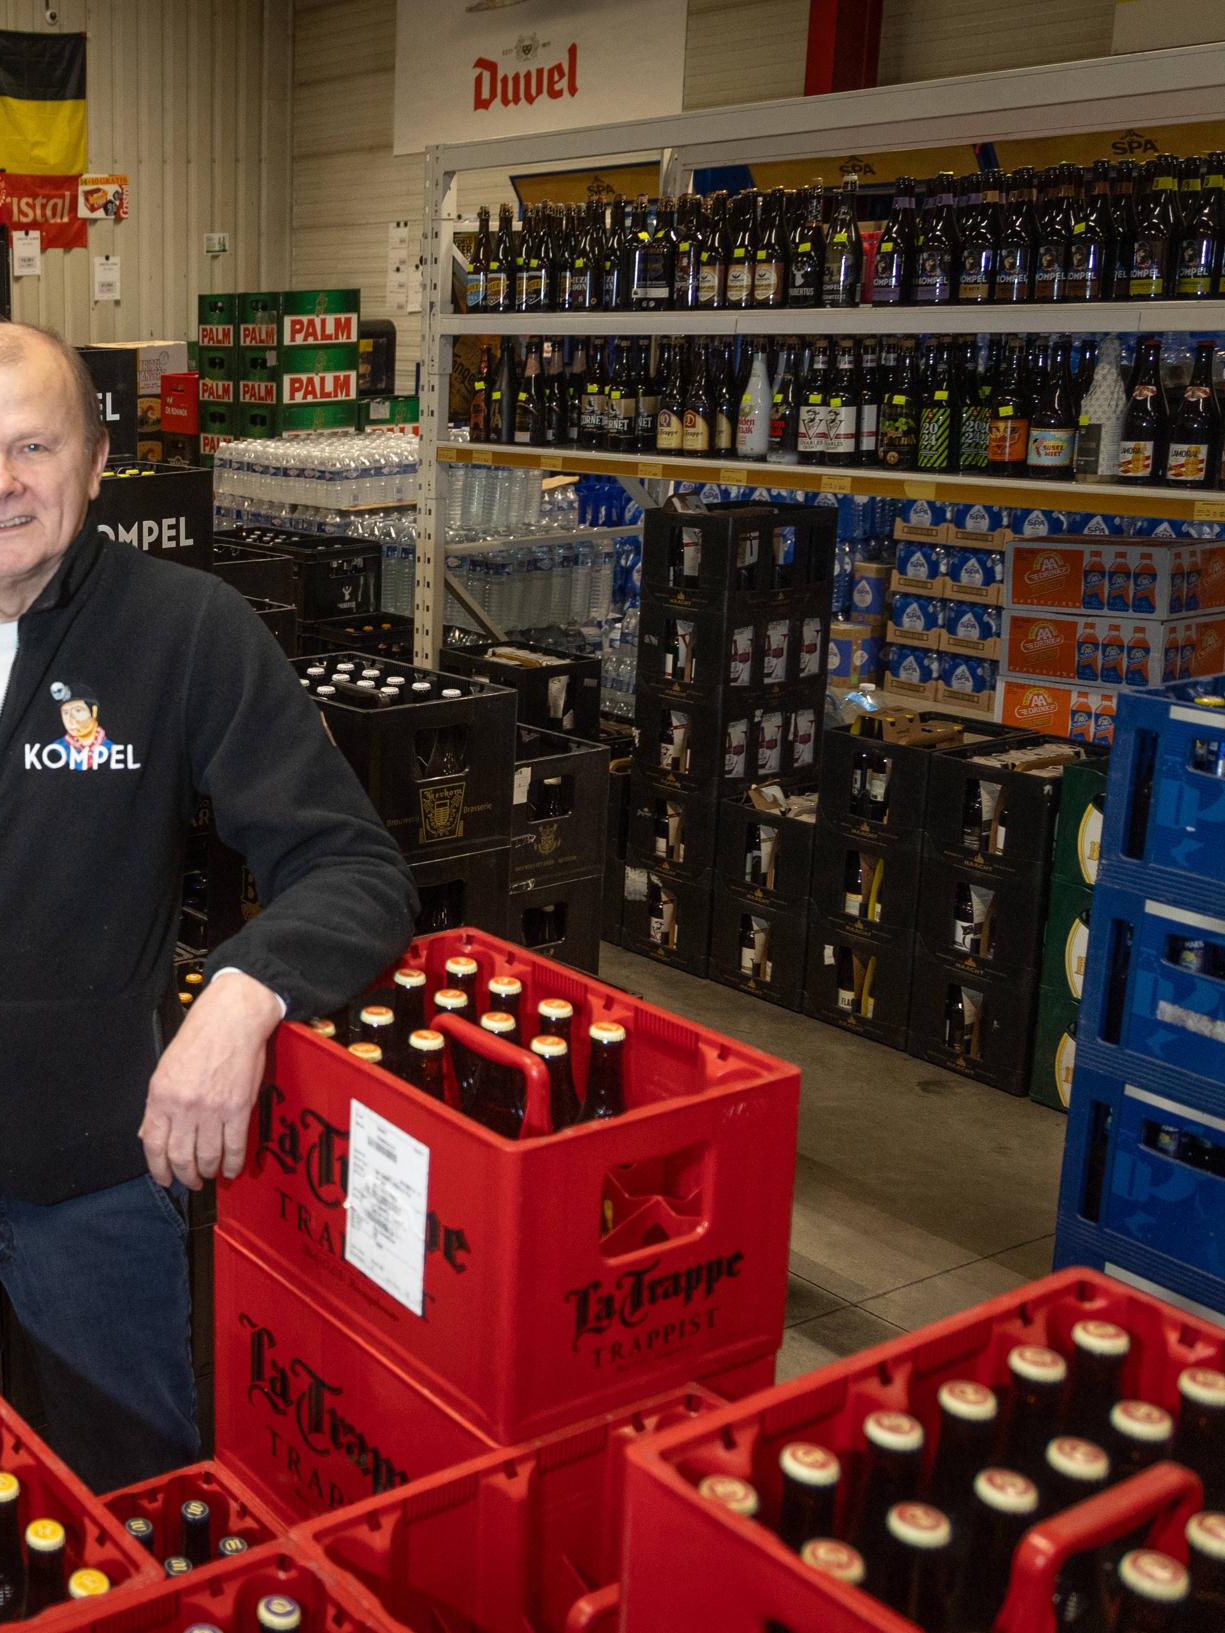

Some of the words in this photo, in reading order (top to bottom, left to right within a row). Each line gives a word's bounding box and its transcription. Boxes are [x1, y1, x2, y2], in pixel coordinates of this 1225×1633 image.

[472, 41, 579, 111] Duvel
[1111, 139, 1157, 155] SPA
[839, 163, 875, 176] SPA
[587, 184, 615, 196] SPA
[6, 191, 70, 223] istal
[201, 327, 231, 345] PALM
[242, 326, 275, 345] PALM
[289, 316, 352, 343] PALM
[201, 383, 231, 401] PALM
[241, 383, 274, 402] PALM
[288, 373, 351, 400] PALM
[922, 423, 938, 434] 20
[923, 434, 937, 445] 24
[24, 743, 141, 770] KOMPEL
[566, 1287, 614, 1352] La
[610, 1250, 745, 1327] Trappe
[591, 1309, 721, 1370] TRAPPIST
[238, 1314, 291, 1416] La
